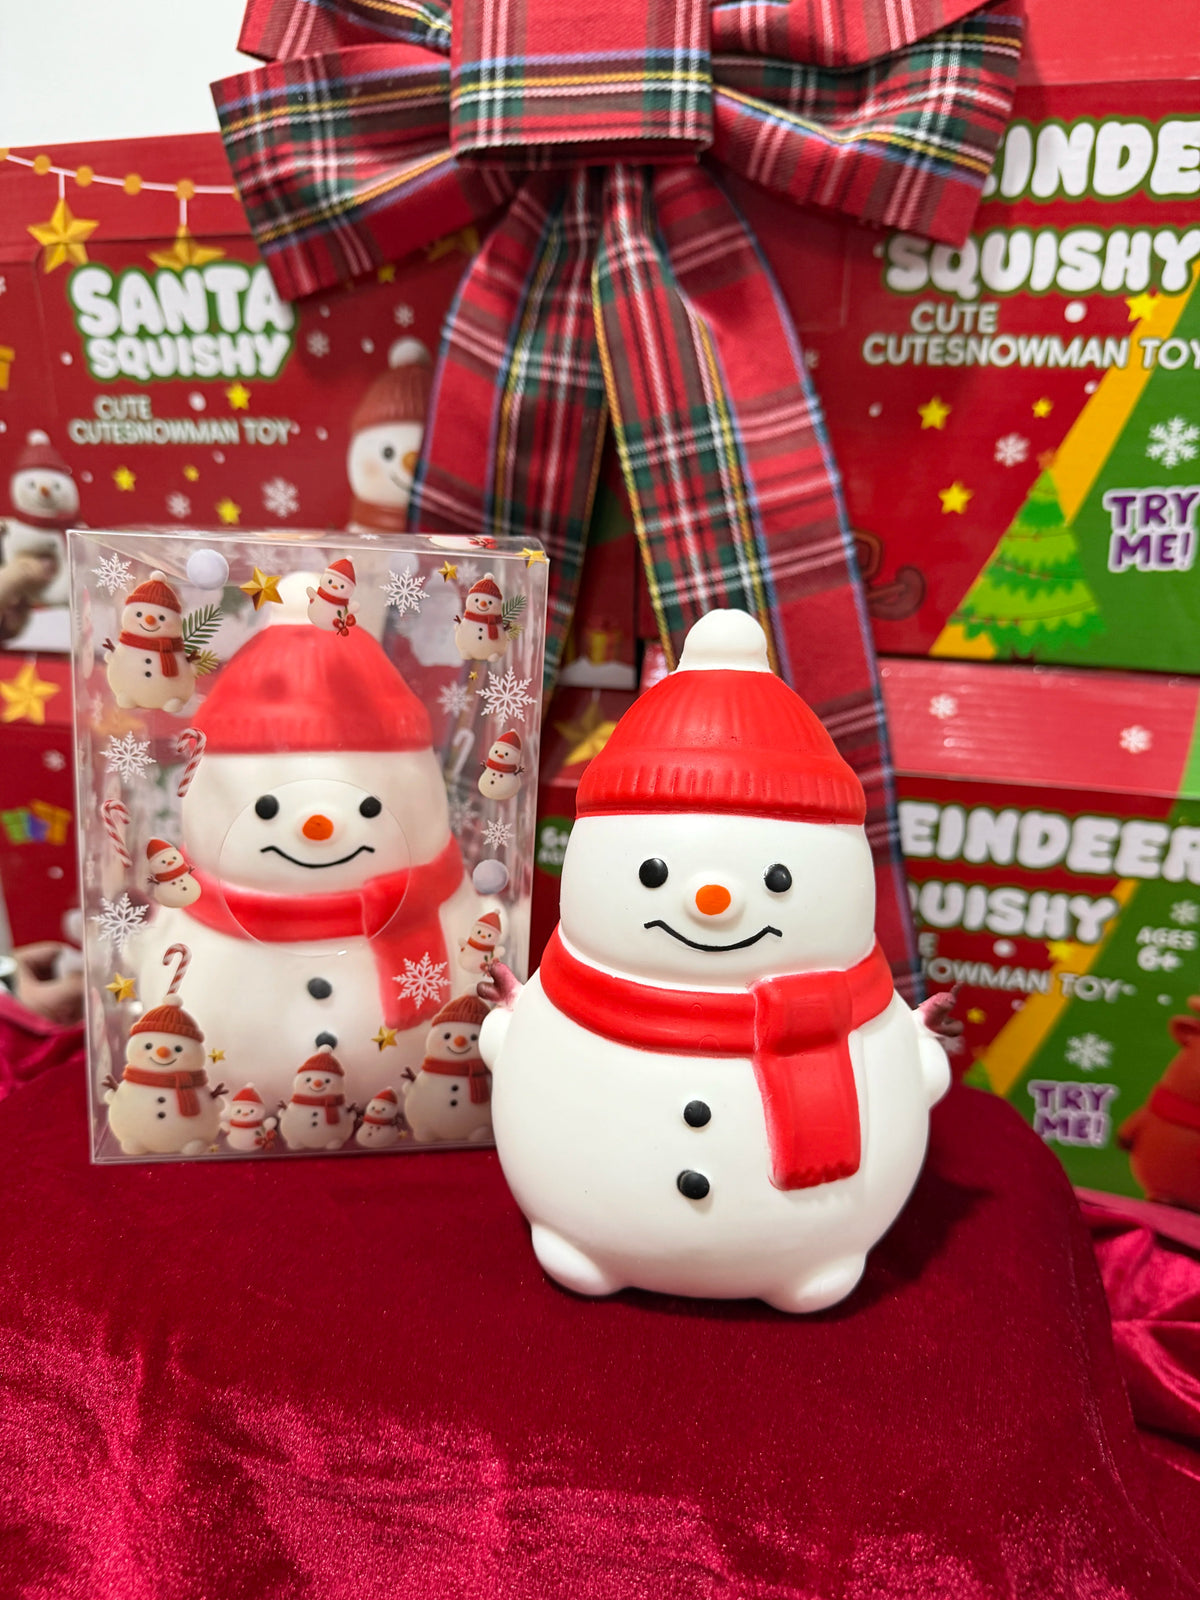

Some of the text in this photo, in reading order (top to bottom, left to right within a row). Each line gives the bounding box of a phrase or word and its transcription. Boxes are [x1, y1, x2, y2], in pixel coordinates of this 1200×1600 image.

[982, 120, 1200, 198] INDE
[885, 229, 1200, 299] SQUISHY
[70, 264, 295, 337] SANTA
[910, 302, 999, 333] CUTE
[87, 331, 291, 379] SQUISHY
[862, 333, 1130, 368] CUTESNOWMAN
[94, 395, 152, 420] CUTE
[69, 417, 291, 445] CUTESNOWMAN TOY
[1105, 489, 1200, 527] TRY
[1110, 530, 1194, 570] ME!
[1136, 926, 1198, 950] AGES
[1137, 946, 1182, 972] 6+
[1059, 973, 1120, 1002] TOY
[1030, 1082, 1116, 1111] TRY
[1035, 1114, 1106, 1146] ME!
